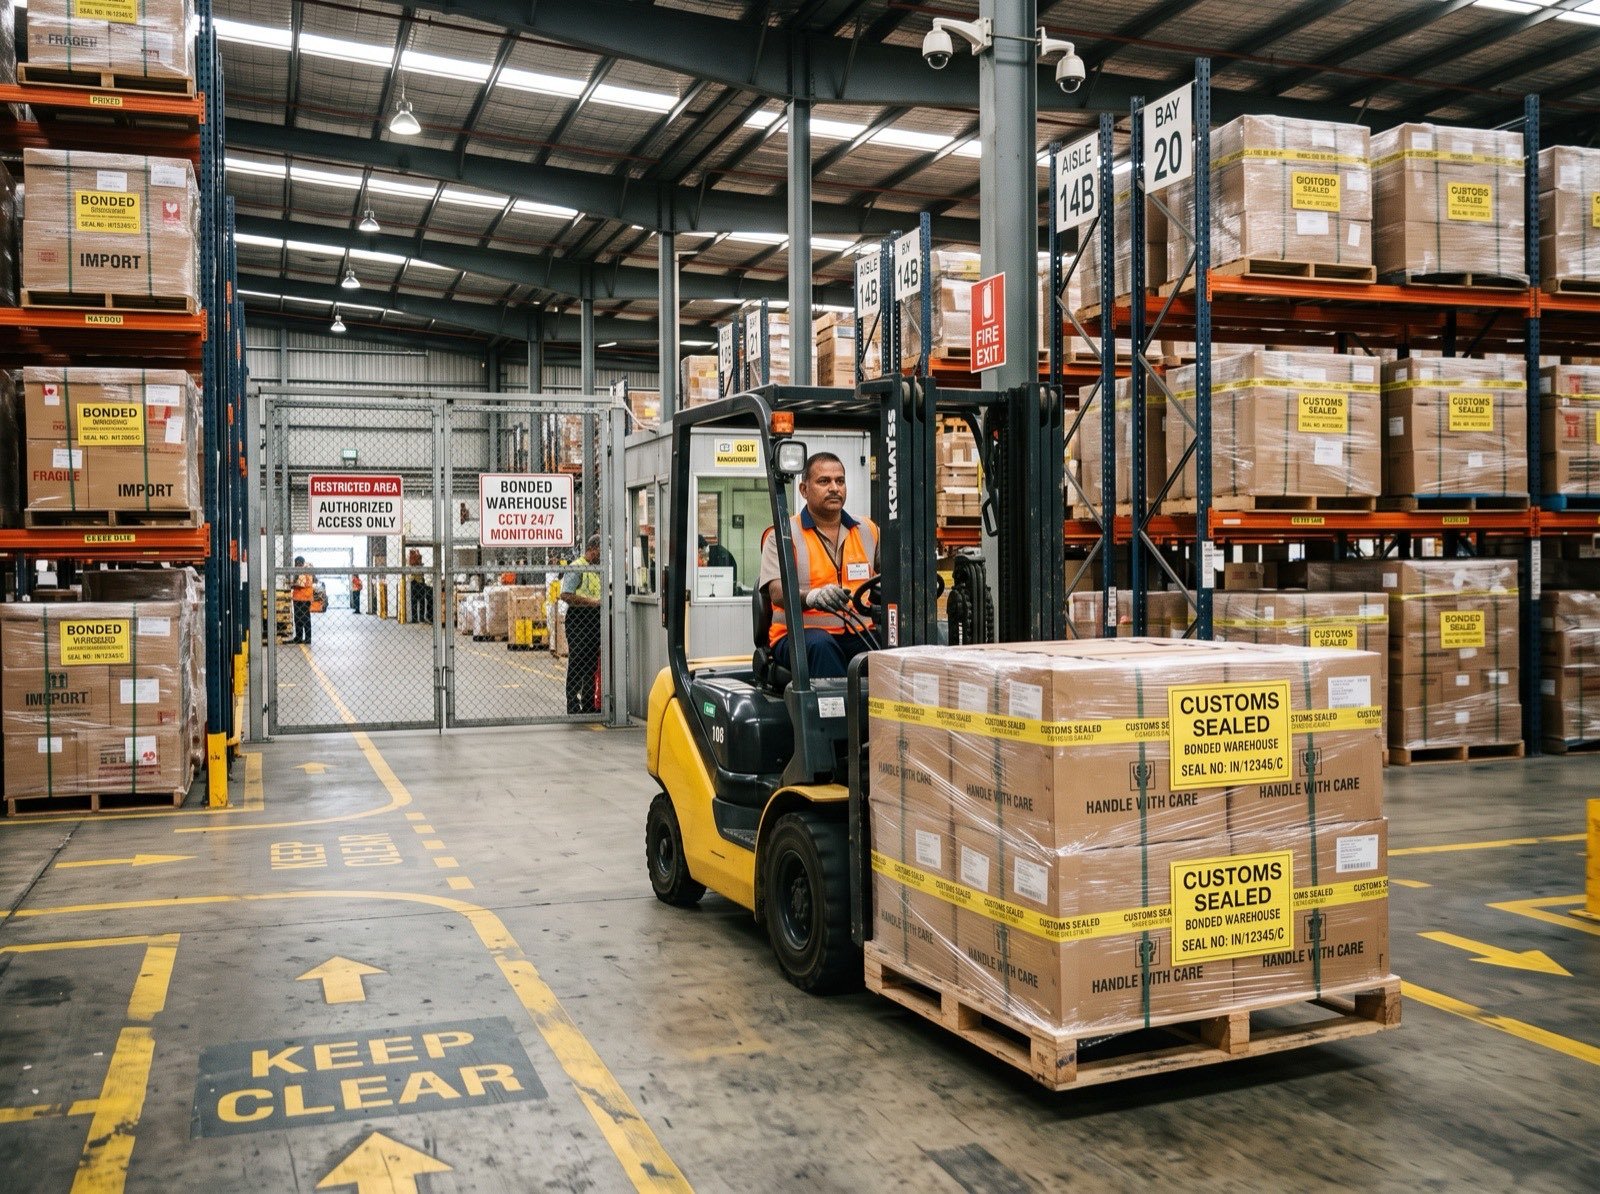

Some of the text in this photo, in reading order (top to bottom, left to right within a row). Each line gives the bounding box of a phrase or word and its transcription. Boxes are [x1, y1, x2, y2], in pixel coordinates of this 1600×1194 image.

[1156, 97, 1180, 128] BAY
[1062, 143, 1092, 175] AISLE
[1154, 130, 1182, 182] 20
[1060, 173, 1094, 222] 14B
[1303, 186, 1330, 194] SEALED
[81, 195, 135, 208] BONDED
[80, 253, 141, 270] IMPORT
[860, 258, 878, 277] AISLE
[898, 258, 918, 292] 14B
[860, 278, 878, 310] 14B
[976, 324, 999, 347] FIRE
[977, 344, 999, 366] EXIT
[1302, 397, 1343, 406] CUSTOMS
[1308, 406, 1338, 414] SEALED
[1452, 398, 1490, 406] CUSTOMS
[83, 408, 138, 418] BONDED
[33, 470, 80, 482] FRAGILE
[118, 484, 174, 497] IMPORT
[314, 482, 398, 492] RESTRICTED AREA
[500, 480, 552, 494] BONDED
[320, 501, 393, 514] AUTHORIZED
[486, 496, 568, 510] WAREHOUSE
[317, 516, 396, 528] ACCESS ONLY
[498, 514, 555, 526] CCTV 24/7
[490, 528, 563, 541] MONITORING
[1445, 614, 1481, 623] BONDED
[67, 624, 122, 636] BONDED
[1314, 630, 1354, 638] CUSTOMS
[1320, 639, 1348, 647] SEALED
[1180, 692, 1280, 715] CUSTOMS
[1007, 720, 1026, 730] SEALED
[1314, 712, 1338, 721] SEALED
[712, 725, 724, 744] 108
[1040, 724, 1102, 734] CUSTOMS SEALED
[1126, 721, 1160, 731] CUSTOMS
[1192, 715, 1270, 737] SEALED
[1184, 738, 1278, 756] BONDED WAREHOUSE
[1181, 756, 1284, 776] SEAL NO: IN/12345/C
[1259, 777, 1360, 799] HANDLE WITH CARE
[1013, 795, 1034, 812] CARE
[1086, 797, 1132, 814] HANDLE
[1169, 792, 1198, 808] CARE
[1183, 862, 1282, 890] CUSTOMS
[1310, 888, 1333, 898] SEALED
[1354, 880, 1382, 892] CUSTOMS
[1194, 886, 1272, 912] SEALED
[984, 898, 1024, 919] CUSTOMS SEALED
[1124, 908, 1172, 922] CUSTOMS SEA
[1040, 918, 1100, 930] CUSTOMS SEALED
[1185, 916, 1223, 931] BONDED
[1225, 908, 1281, 926] WAREHOUSE
[1182, 927, 1284, 952] SEAL NO: IN/12345/C
[1262, 950, 1305, 968] HANDLE
[1337, 940, 1364, 957] CARE
[968, 946, 996, 970] HANDLE
[1017, 966, 1038, 988] CARE
[1092, 974, 1138, 994] HANDLE
[1174, 965, 1203, 982] CARE
[252, 1030, 475, 1078] KEEP
[216, 1063, 525, 1123] CLEAR
